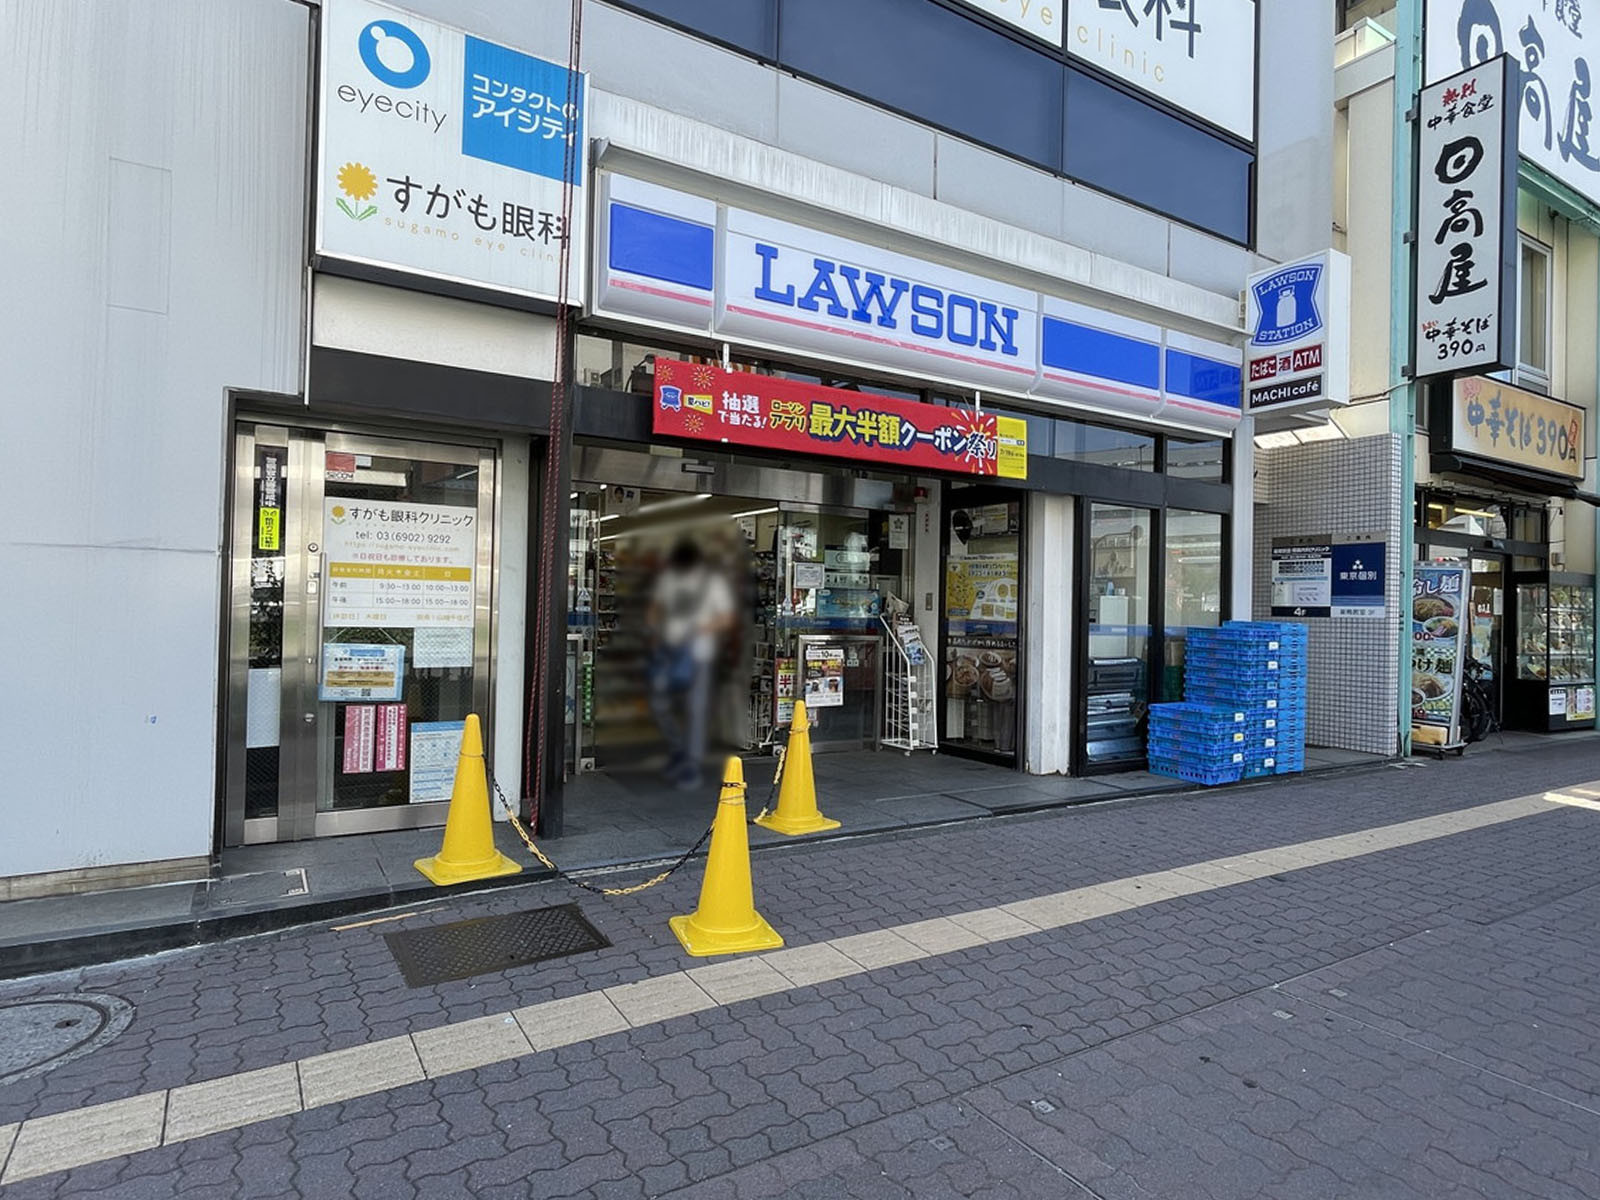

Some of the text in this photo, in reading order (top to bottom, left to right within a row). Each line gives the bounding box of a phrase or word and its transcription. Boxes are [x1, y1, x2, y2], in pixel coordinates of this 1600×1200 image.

[1077, 25, 1164, 82] clinic
[337, 84, 447, 133] eyecity
[472, 73, 579, 121] コンタクトの
[1427, 93, 1494, 131] 中華食堂
[386, 175, 569, 249] すがも眼科
[1428, 136, 1488, 305] 日高屋
[384, 216, 459, 242] sugamo
[474, 237, 505, 252] eye
[1258, 269, 1316, 296] LAWSON
[753, 241, 1020, 357] LAWSON
[1258, 318, 1315, 342] STATION
[1425, 314, 1492, 343] 中華そば
[1437, 338, 1486, 360] 390円
[1251, 359, 1277, 379] たばこ
[1294, 348, 1321, 369] ATM
[722, 391, 760, 414] 抽選
[770, 400, 806, 415] ローソン
[718, 410, 767, 429] で当たる!
[769, 412, 807, 433] アプリ
[349, 507, 474, 527] すがも眼科クリニック
[355, 531, 373, 540] tel:
[1340, 570, 1377, 580] 東京個別
